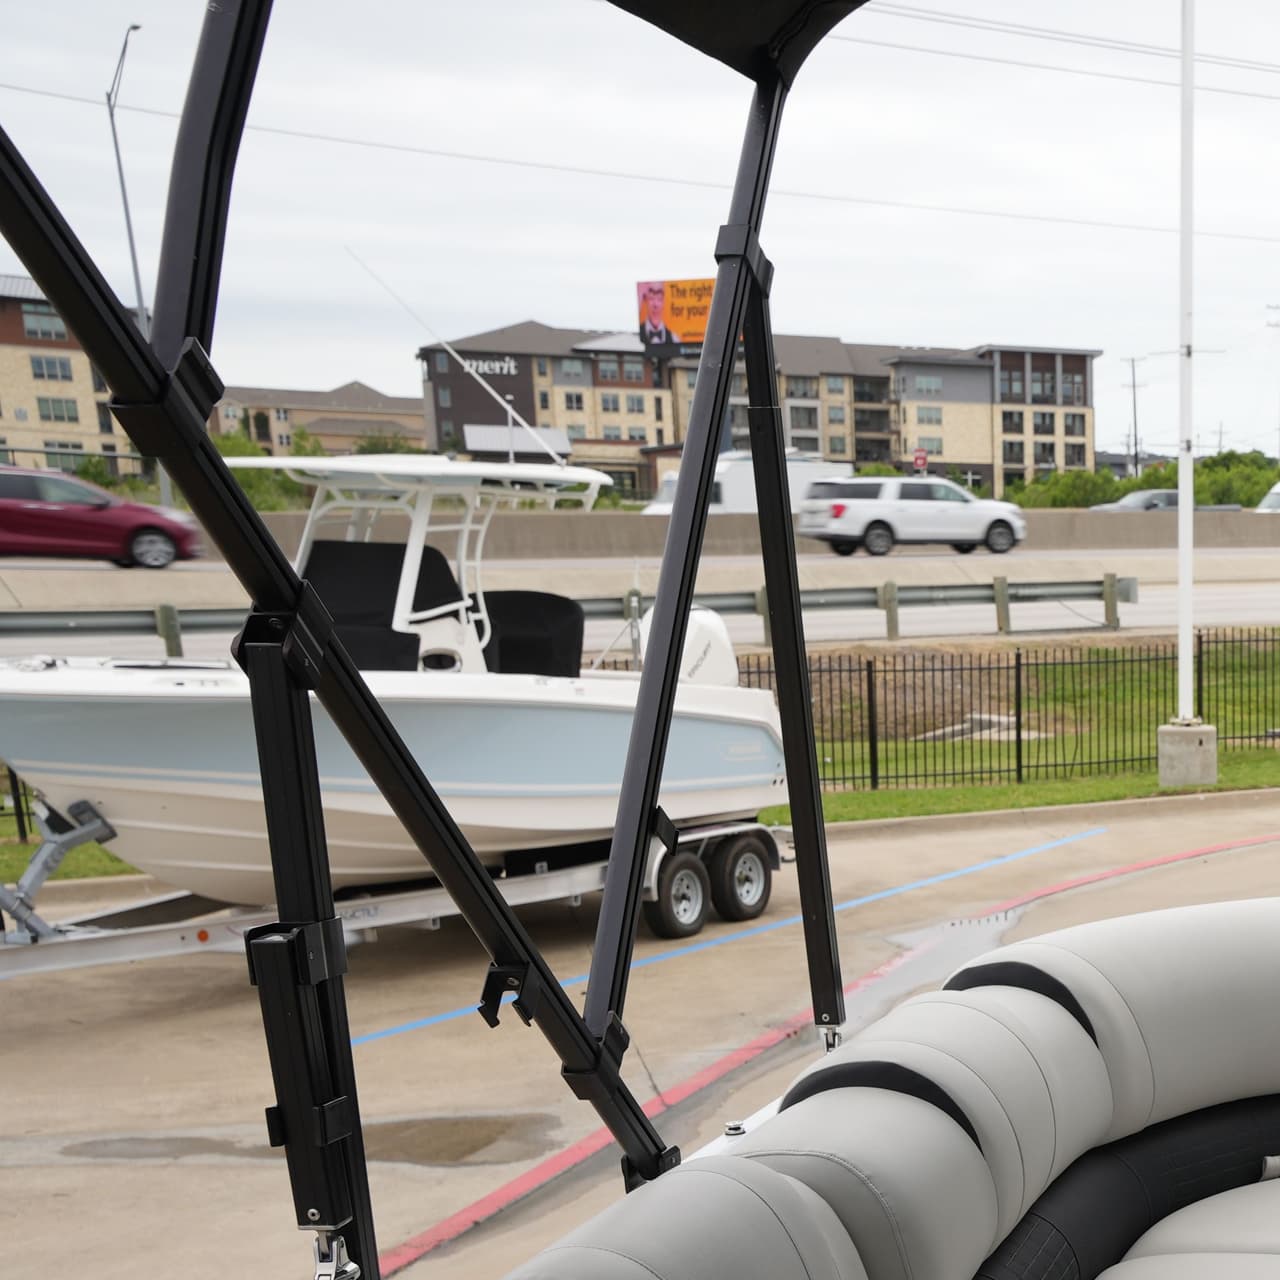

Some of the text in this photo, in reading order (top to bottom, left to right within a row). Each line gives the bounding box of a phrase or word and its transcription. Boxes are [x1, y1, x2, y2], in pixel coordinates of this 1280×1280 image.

[670, 284, 712, 301] The right
[671, 303, 708, 320] for your
[463, 356, 518, 375] merit
